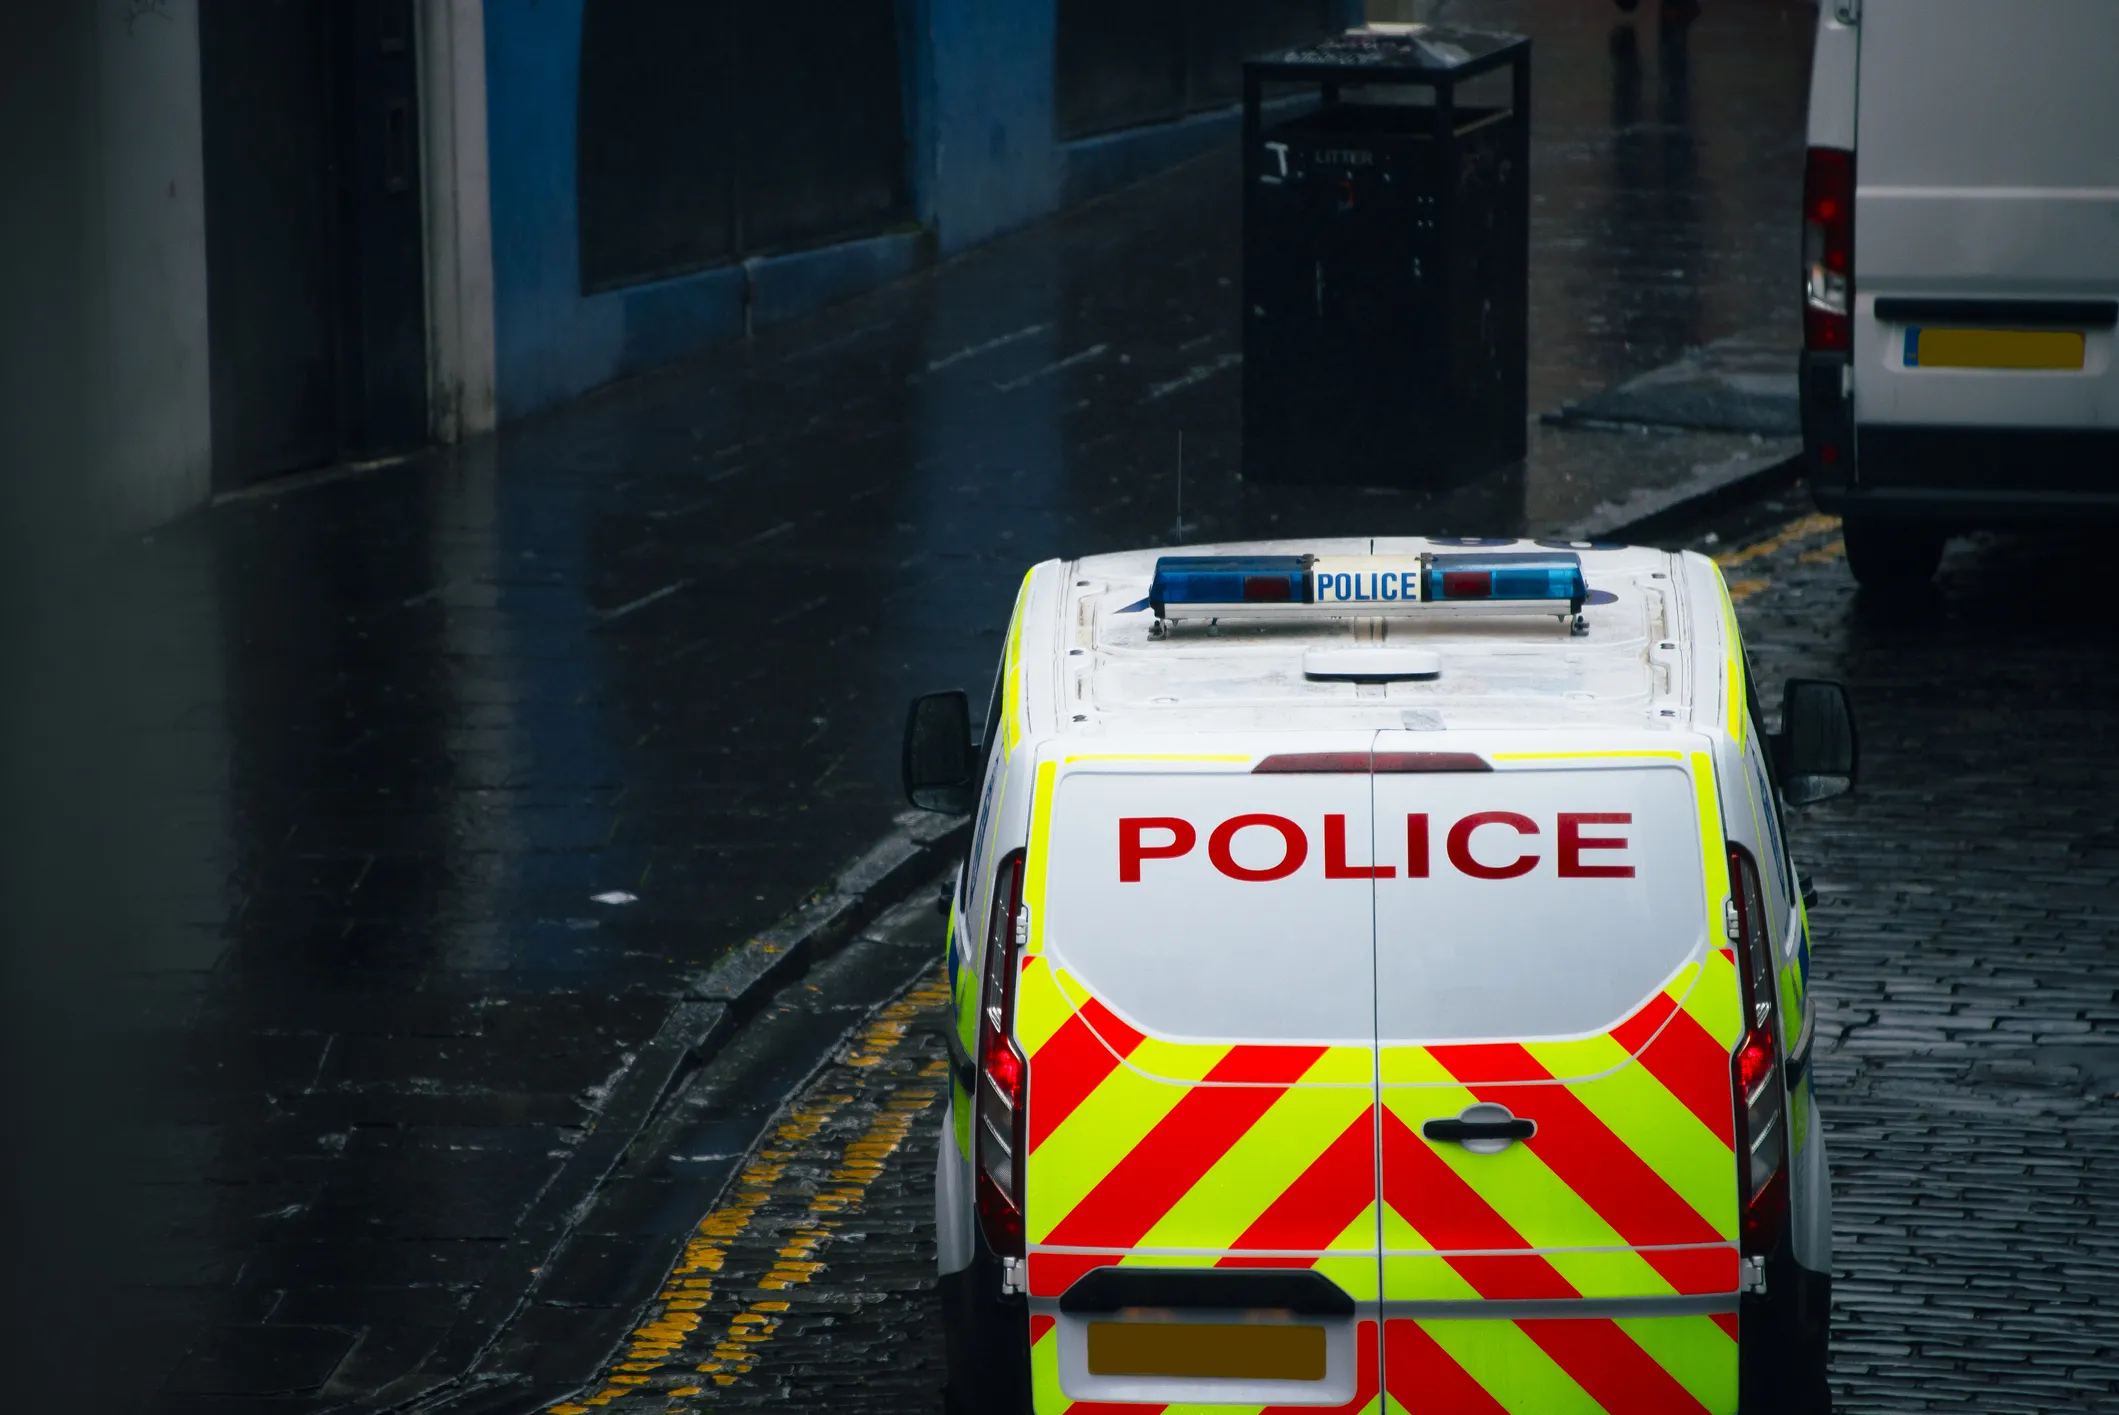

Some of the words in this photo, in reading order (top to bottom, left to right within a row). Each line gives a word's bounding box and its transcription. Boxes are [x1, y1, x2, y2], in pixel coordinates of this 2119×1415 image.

[1315, 149, 1374, 165] LITTER
[1317, 572, 1417, 601] POLICE
[1119, 811, 1636, 882] POLICE
